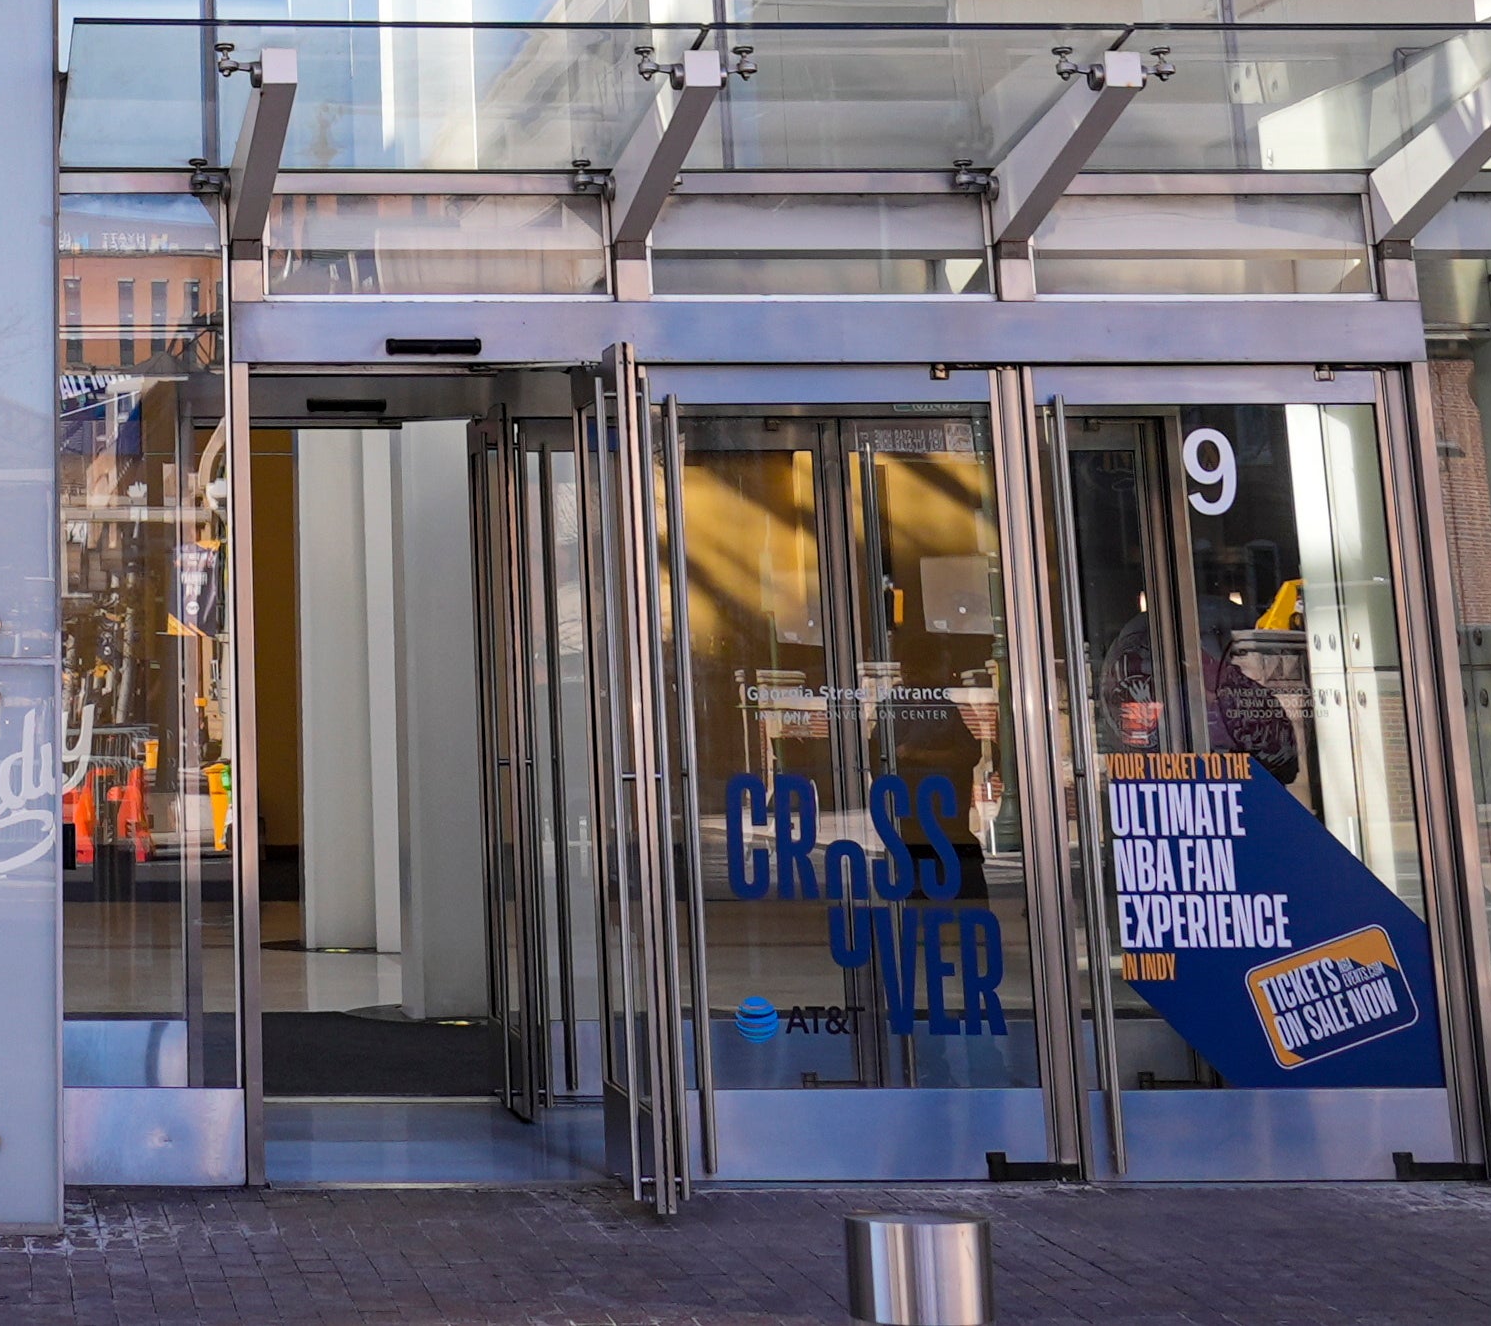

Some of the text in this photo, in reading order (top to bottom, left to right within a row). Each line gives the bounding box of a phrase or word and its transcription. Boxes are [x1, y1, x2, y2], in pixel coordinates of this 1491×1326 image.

[59, 374, 91, 400] ALE
[1183, 427, 1238, 516] 9
[747, 685, 813, 702] Georgia
[878, 686, 951, 701] Entrance
[902, 710, 948, 720] CENTER
[1104, 753, 1252, 780] YOUR TICKET TO THE
[725, 772, 962, 902] CROSS
[1108, 783, 1246, 837] ULTIMATE
[1112, 838, 1236, 892] NBA FAN
[1117, 894, 1292, 948] EXPERIENCE
[828, 906, 1008, 1036] OVER
[1121, 953, 1176, 981] IN INDY
[1257, 957, 1341, 1015] TICKETS
[785, 1005, 865, 1035] AT&T
[1274, 977, 1398, 1051] ON SALE NOW
